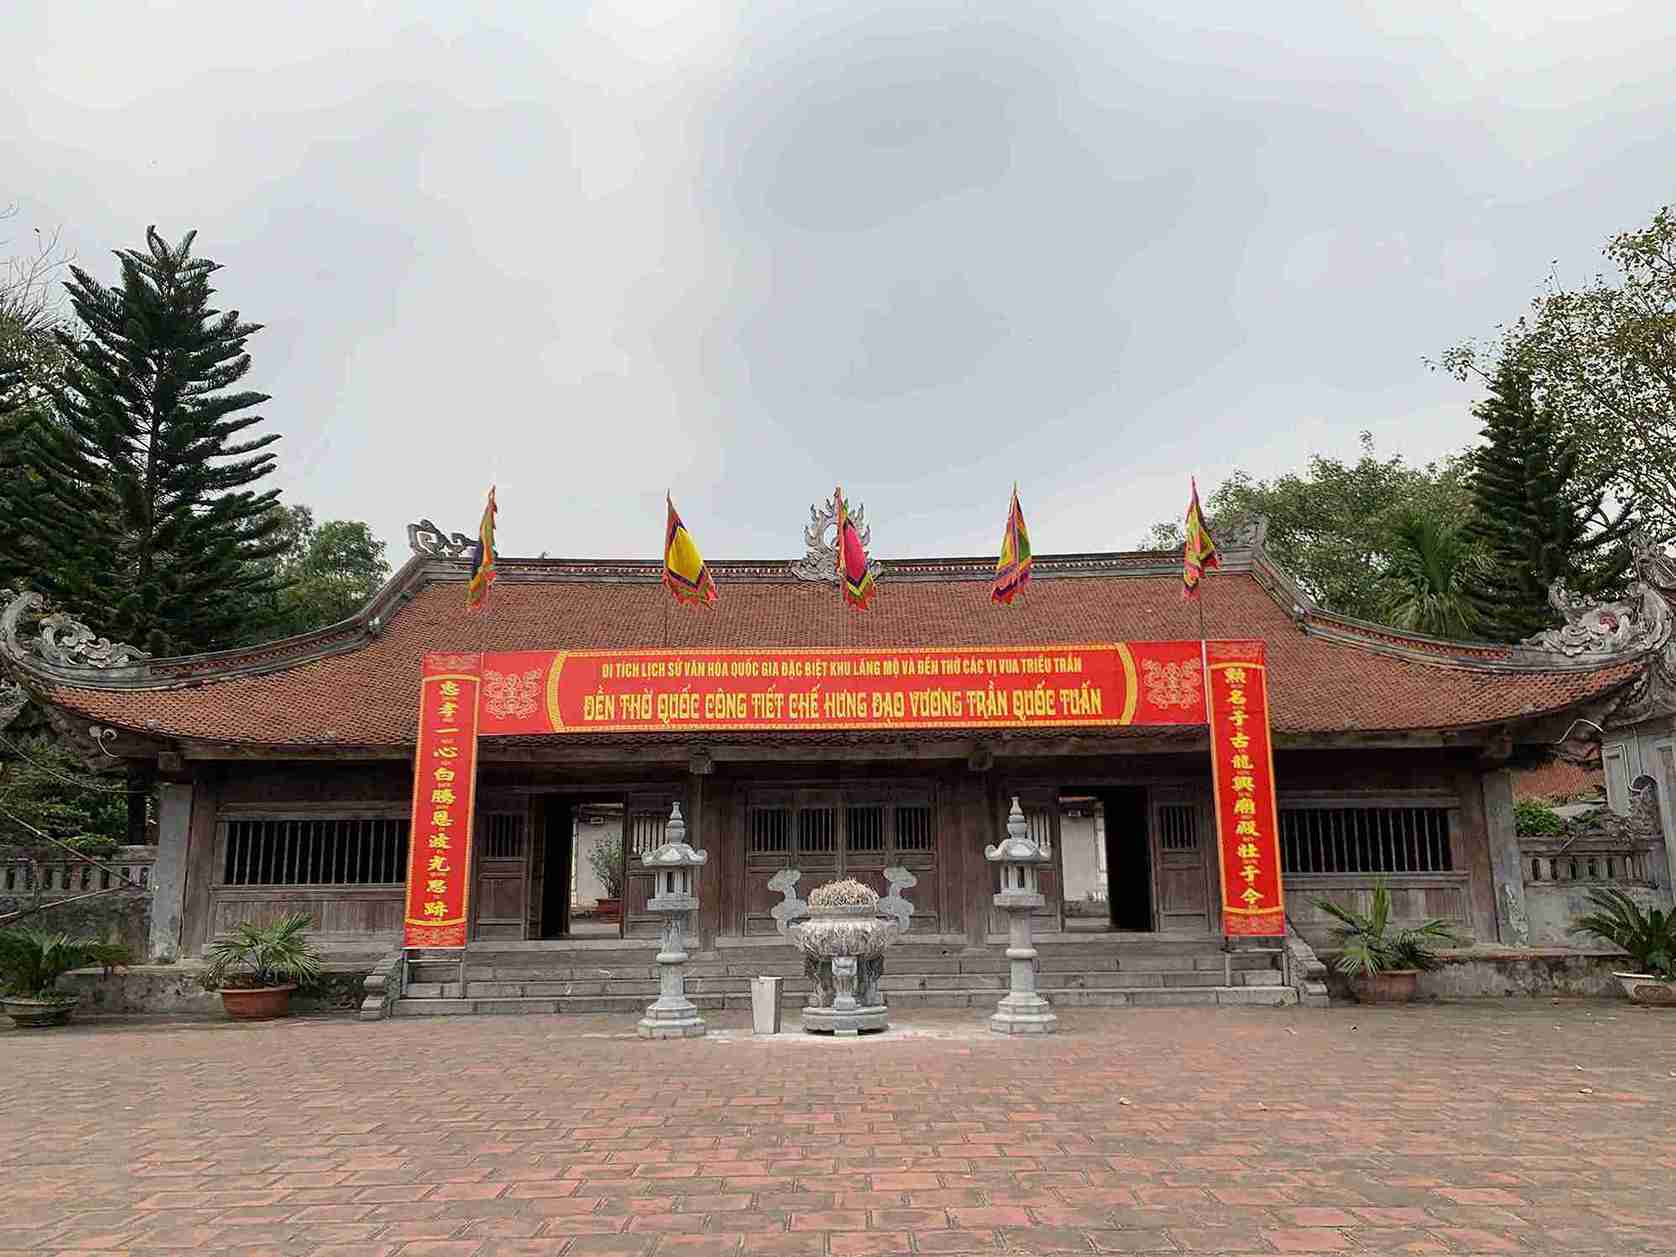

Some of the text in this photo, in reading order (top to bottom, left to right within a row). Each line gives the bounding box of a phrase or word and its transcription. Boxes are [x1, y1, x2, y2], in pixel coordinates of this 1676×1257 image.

[616, 660, 639, 677] TÍCH
[642, 661, 665, 680] LỊCH
[668, 658, 682, 677] SỬ
[730, 657, 758, 677] QUỐC
[761, 659, 780, 677] GIA
[781, 659, 802, 679] ĐẶC
[805, 658, 828, 679] BIỆT
[830, 660, 850, 676] KHU
[884, 657, 898, 679] MỘ
[902, 657, 917, 676] VÀ
[918, 656, 939, 675] ĐỀN
[941, 656, 960, 675] THỜ
[962, 655, 985, 674] CÁC
[986, 658, 997, 677] VỊ
[998, 658, 1019, 674] VUA
[1021, 654, 1051, 674] TRIỀU
[1054, 652, 1082, 673] TRẦN
[584, 680, 1103, 727] ĐỀN THỜ QUỐC CÔNG TIẾT CHẾ HƯNG ĐẠO VƯƠNG TRẦN QUỐC TUẤN
